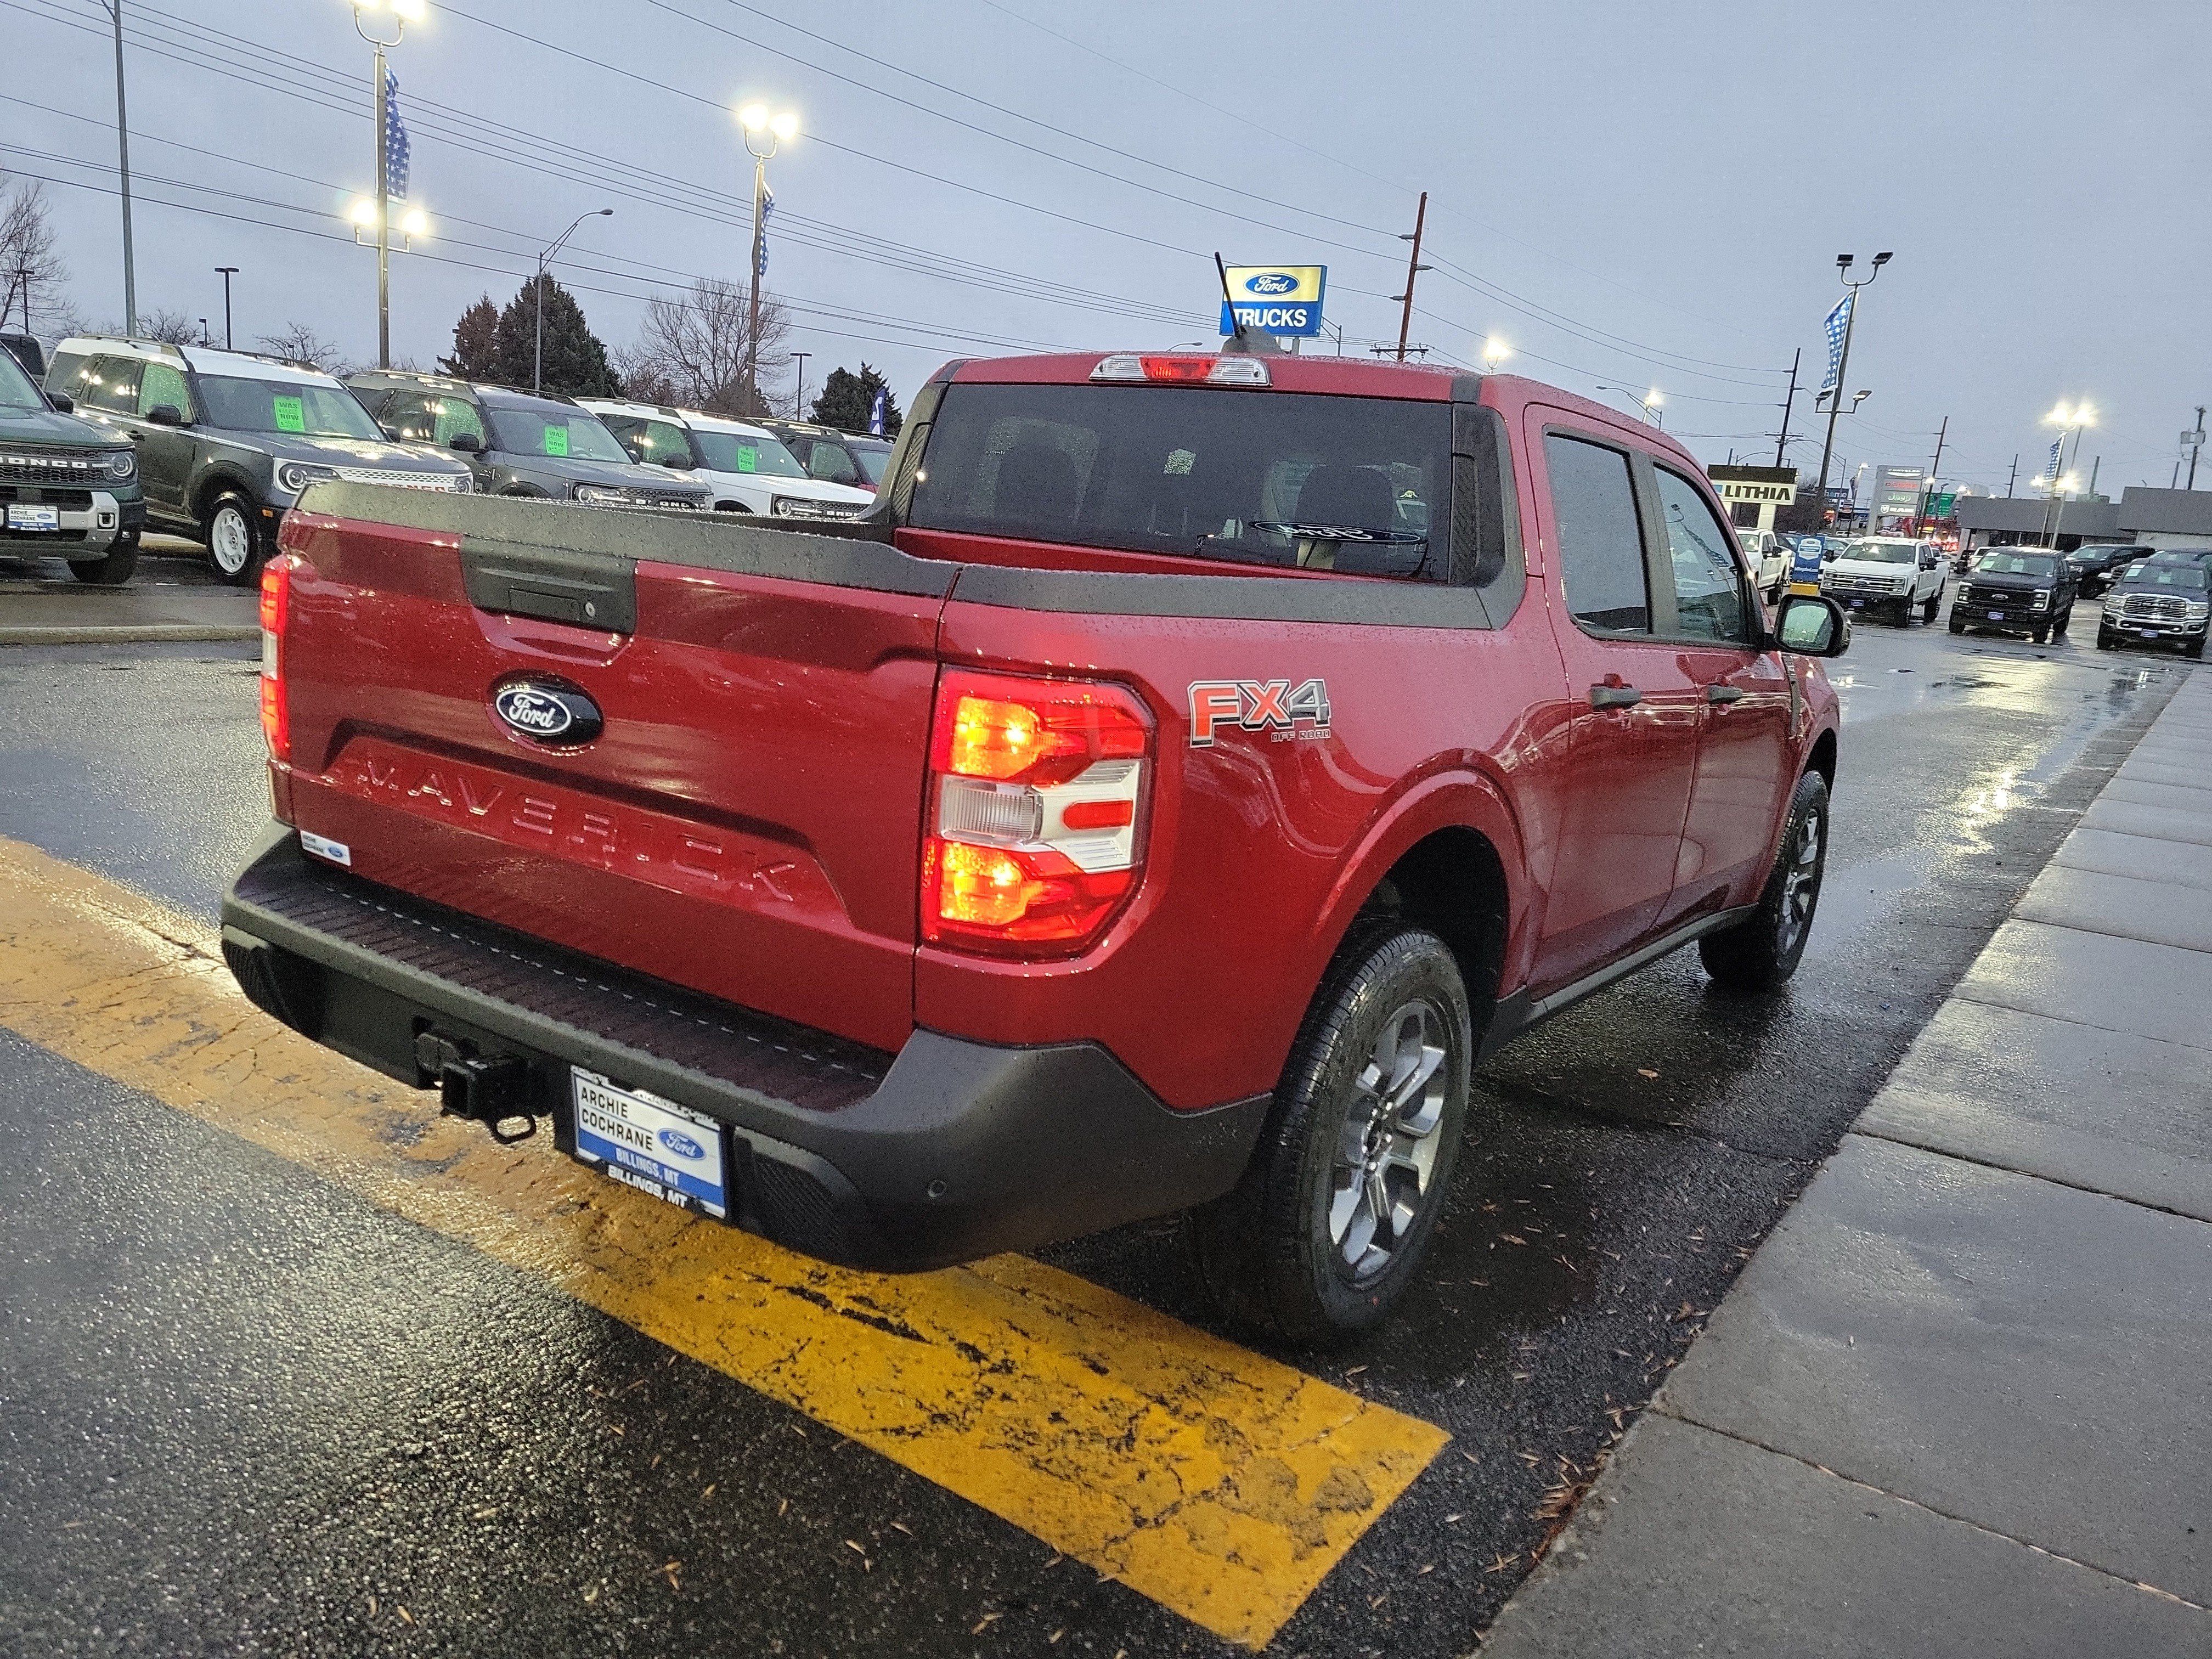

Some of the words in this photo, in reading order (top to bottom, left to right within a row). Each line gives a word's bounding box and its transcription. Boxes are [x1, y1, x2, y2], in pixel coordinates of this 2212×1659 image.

[1254, 275, 1289, 292] Ford
[1234, 308, 1307, 328] TRUCKS
[0, 456, 87, 468] ONCO
[1724, 485, 1791, 500] LITHIA
[1888, 493, 1911, 503] Jeep
[509, 693, 557, 728] Ford
[1187, 679, 1331, 748] FX4
[1271, 731, 1295, 742] OFF
[1299, 729, 1331, 740] ROAD
[581, 1087, 628, 1119] ARCHIE
[582, 1108, 653, 1152] COCHRANE
[665, 1132, 696, 1157] Ford
[616, 1147, 663, 1180] BILLINGS,
[664, 1167, 680, 1187] MT
[608, 1164, 665, 1200] BILLINGS,
[667, 1189, 687, 1209] MT
